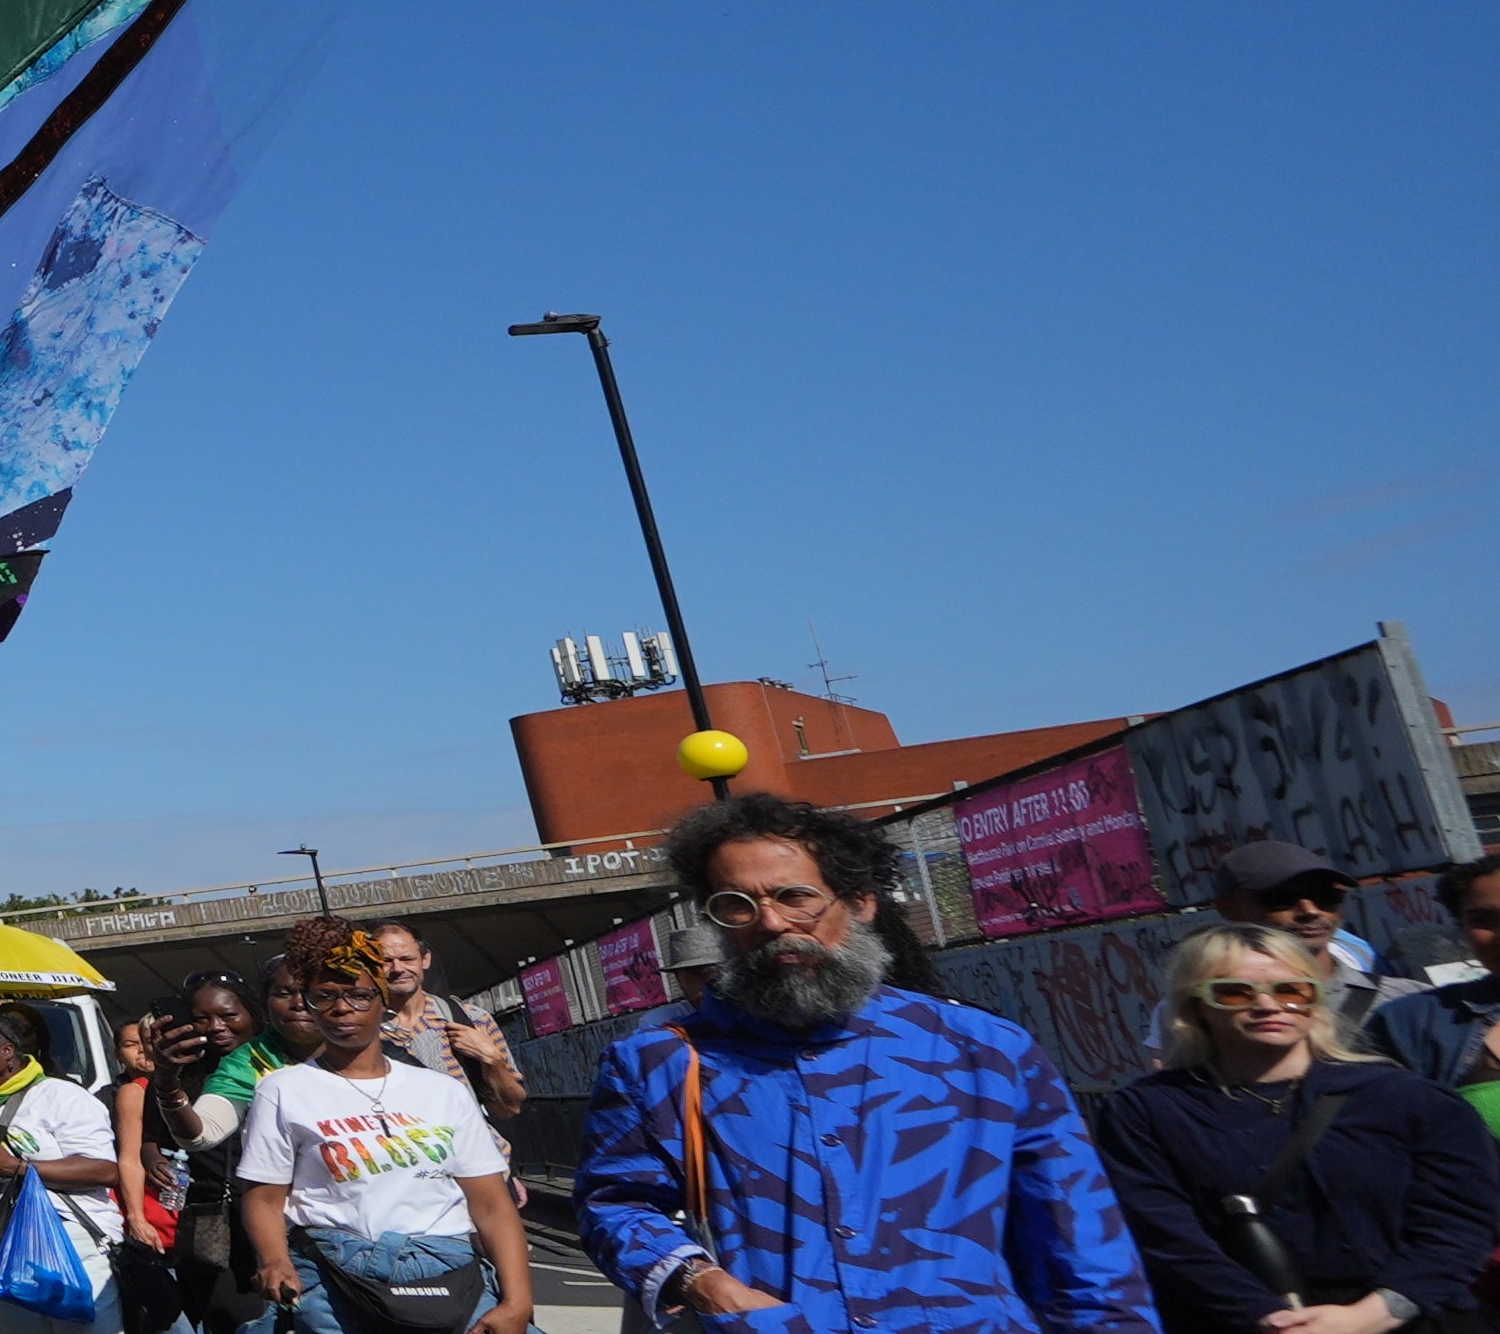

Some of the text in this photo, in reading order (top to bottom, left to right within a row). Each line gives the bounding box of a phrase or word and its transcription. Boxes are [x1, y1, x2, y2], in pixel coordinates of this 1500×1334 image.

[973, 805, 1009, 840] ENTRY
[1012, 792, 1050, 829] AFTER
[390, 1286, 450, 1297] SAMSUNG
